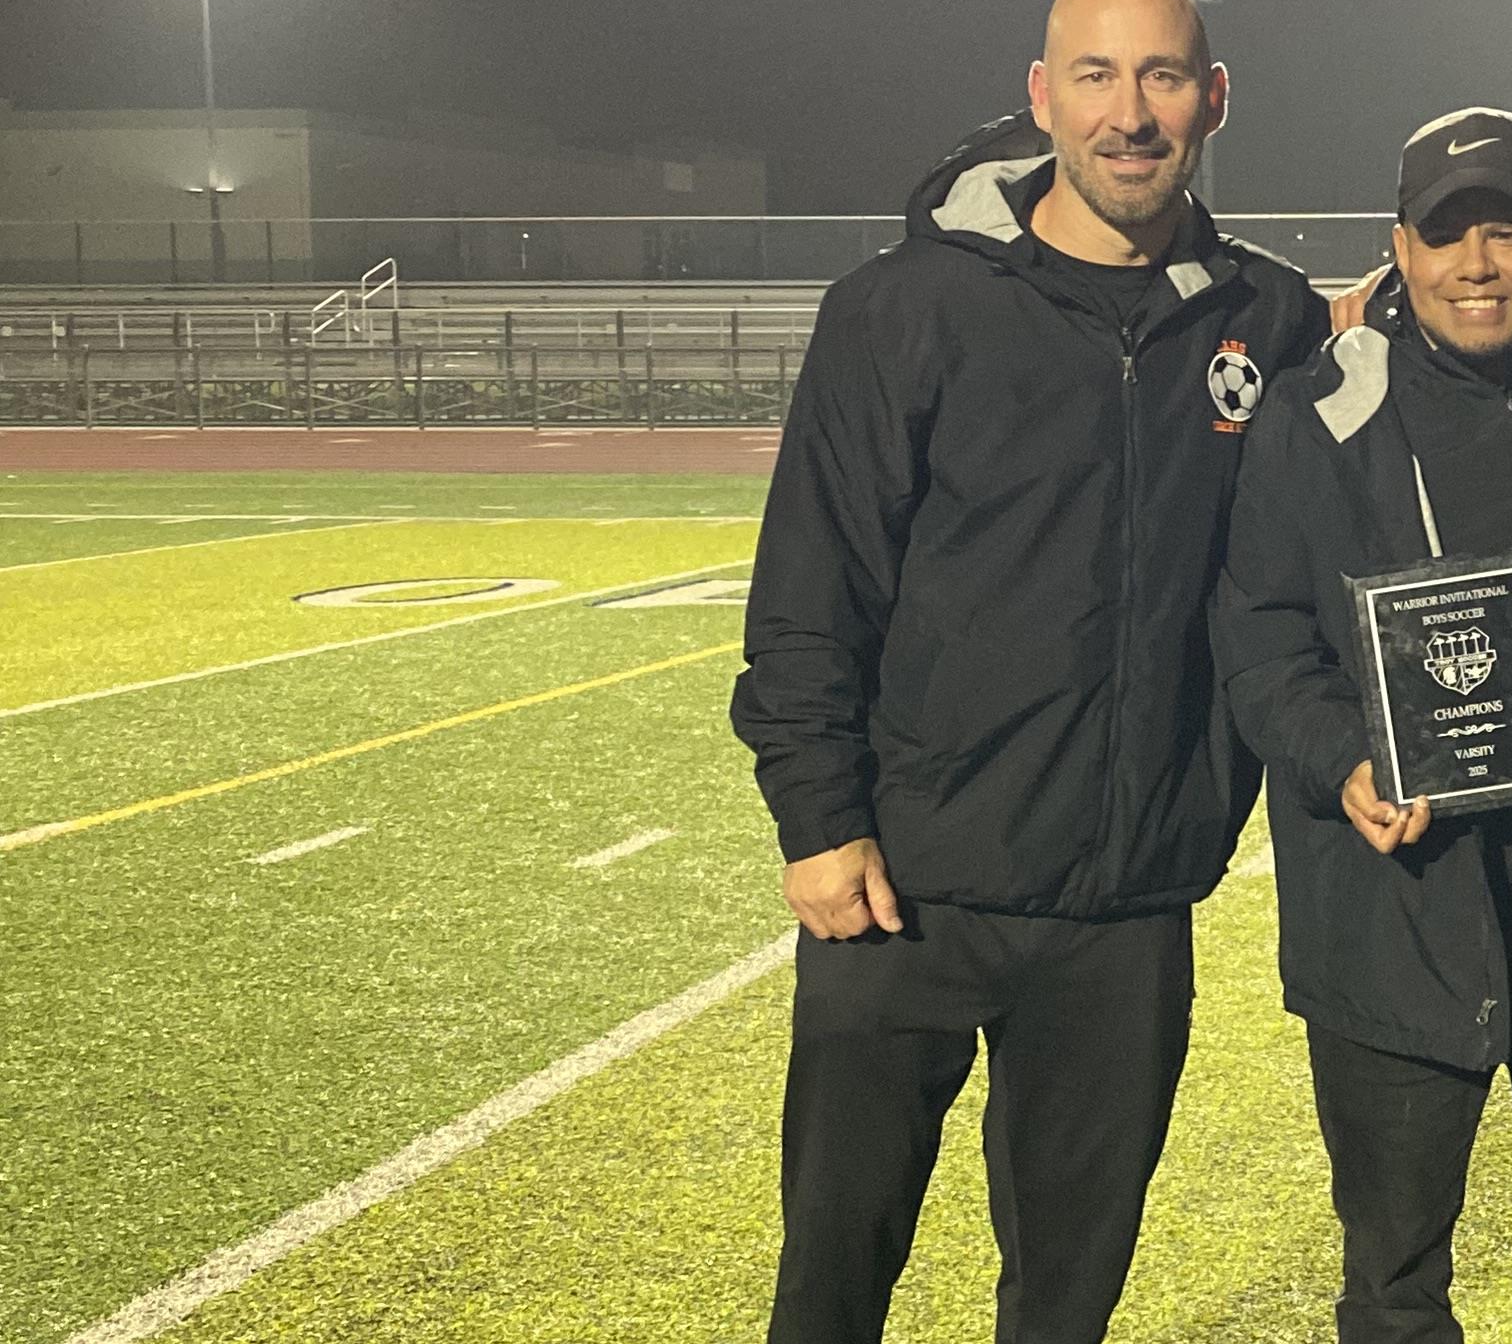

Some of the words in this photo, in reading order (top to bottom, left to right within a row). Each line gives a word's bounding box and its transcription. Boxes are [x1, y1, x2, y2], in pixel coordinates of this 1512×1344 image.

[1393, 596, 1439, 612] WARRIOR
[1439, 586, 1508, 604] INVITATIONAL
[1422, 613, 1447, 626] BOYS
[1447, 607, 1486, 622] SOCCER
[1434, 700, 1503, 720] CHAMPIONS
[1454, 744, 1496, 760] VARSITY
